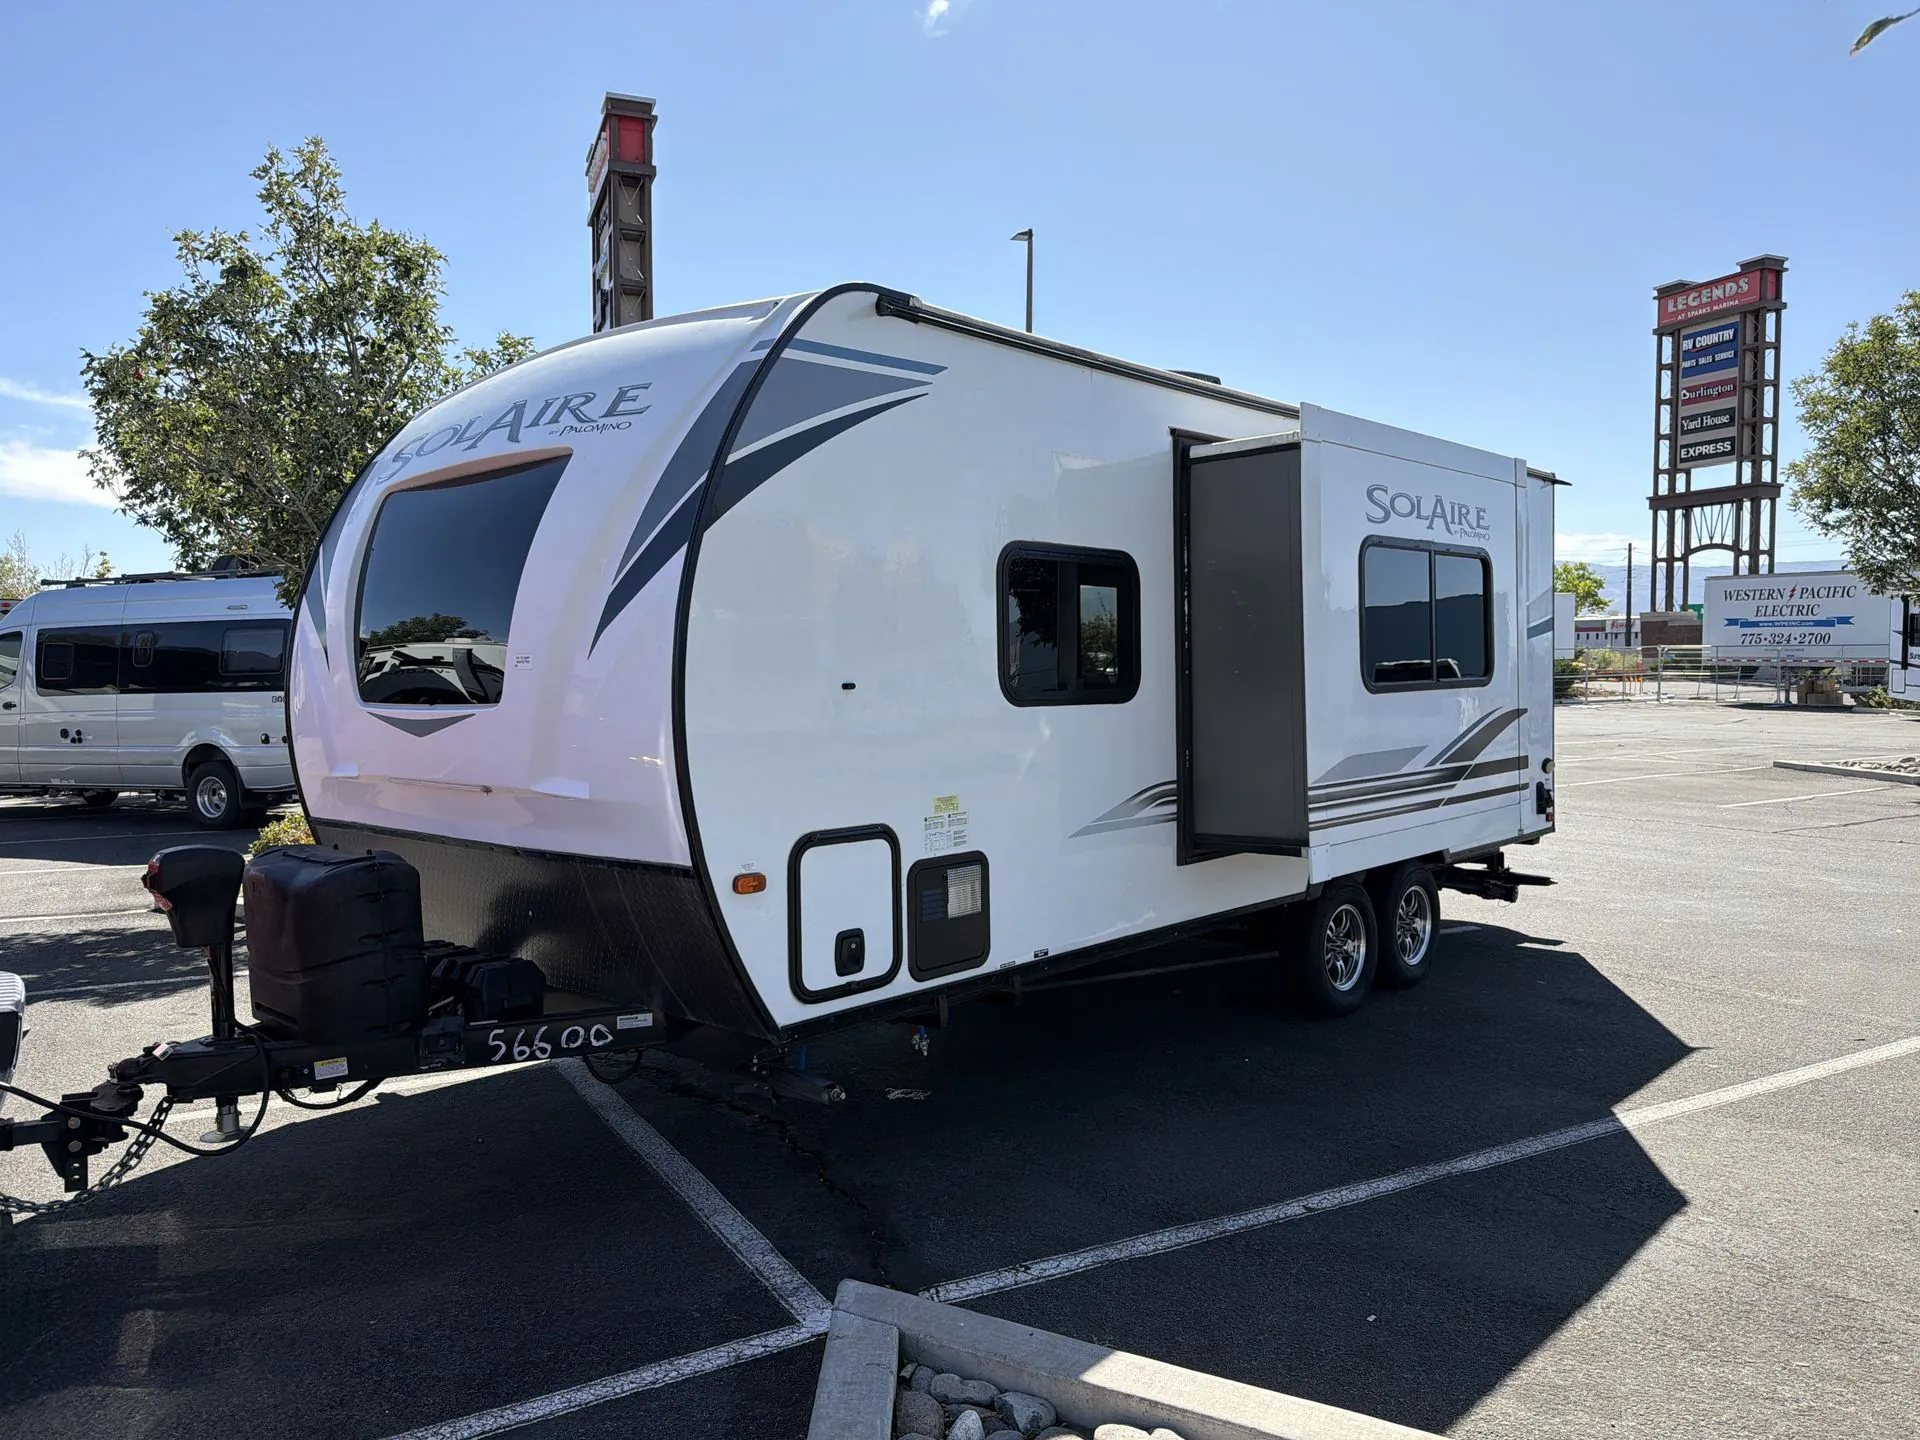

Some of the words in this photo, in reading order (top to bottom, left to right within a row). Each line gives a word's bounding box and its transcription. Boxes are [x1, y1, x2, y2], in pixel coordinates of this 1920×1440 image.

[1667, 277, 1749, 313] LEGENDS
[1677, 313, 1686, 321] AT
[1687, 307, 1711, 319] SPARKS
[1713, 299, 1739, 312] MARINA
[1682, 338, 1694, 351] RV
[1695, 328, 1735, 348] COUNTRY
[1681, 359, 1697, 369] PARTS
[1698, 355, 1713, 365] SALES
[1714, 350, 1735, 362] SERVICE
[1681, 383, 1734, 400] Burlington
[559, 421, 632, 437] PALOMINO
[1682, 416, 1702, 431] Yard
[1702, 414, 1730, 427] House
[1680, 441, 1732, 459] EXPRESS
[1459, 527, 1491, 541] PALOMINO
[1723, 587, 1786, 602] WESTERN
[1799, 585, 1857, 600] PACIFIC
[1754, 603, 1821, 618] ELECTRIC
